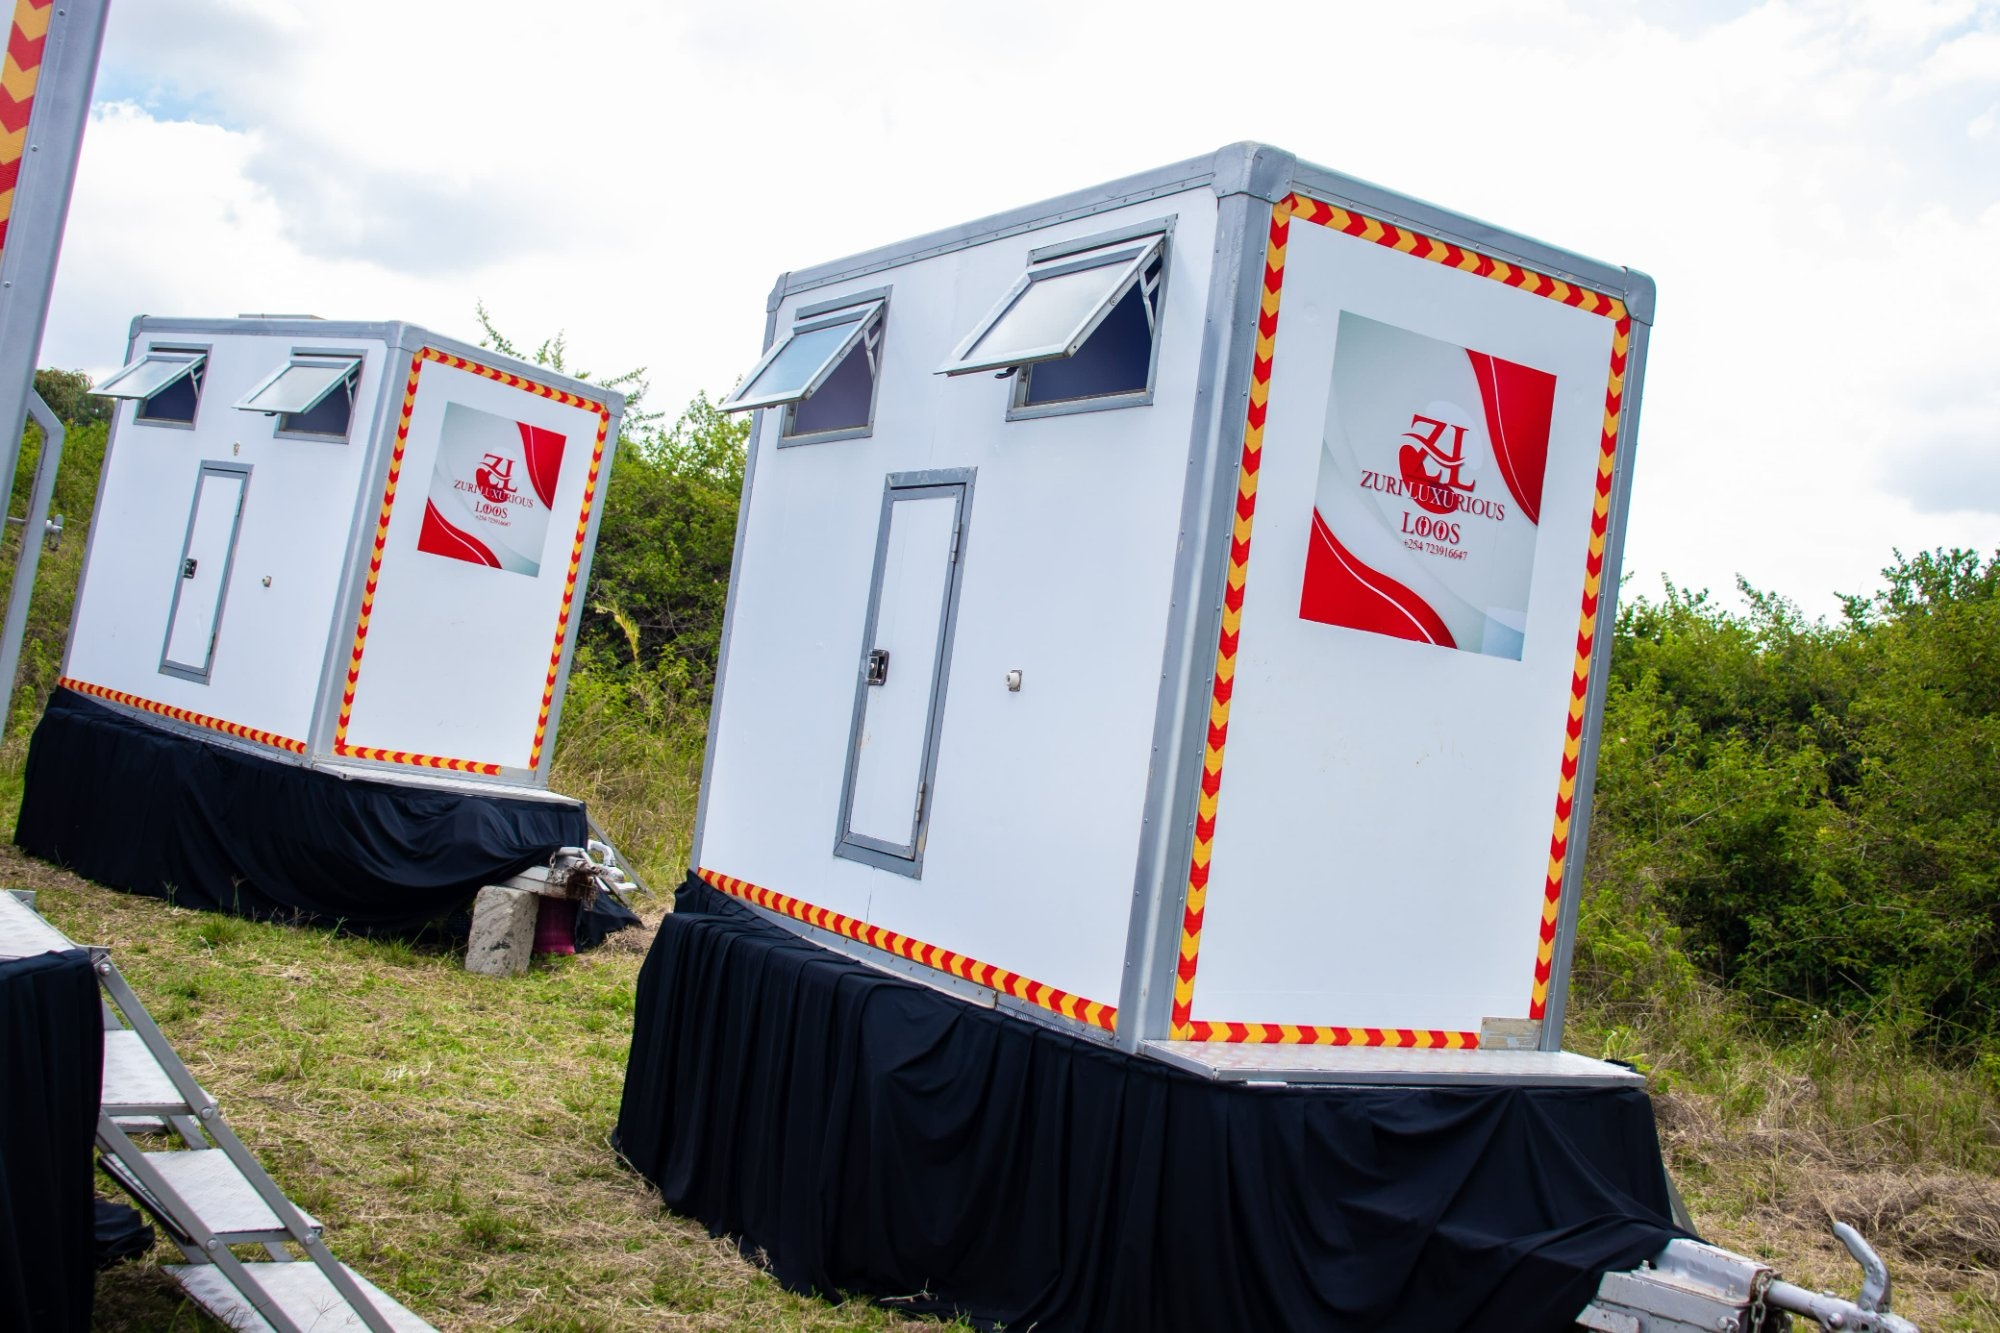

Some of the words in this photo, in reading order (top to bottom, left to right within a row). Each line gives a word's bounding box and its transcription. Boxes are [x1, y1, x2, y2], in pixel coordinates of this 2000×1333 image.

[453, 479, 477, 494] ZURI
[480, 486, 534, 508] LUXURIOUS
[1360, 470, 1402, 497] ZURI
[1408, 481, 1505, 521] LUXURIOUS
[475, 500, 508, 519] LOOS
[1401, 511, 1461, 545] LOOS
[1403, 538, 1423, 551] +254
[1425, 542, 1468, 560] 723916647
